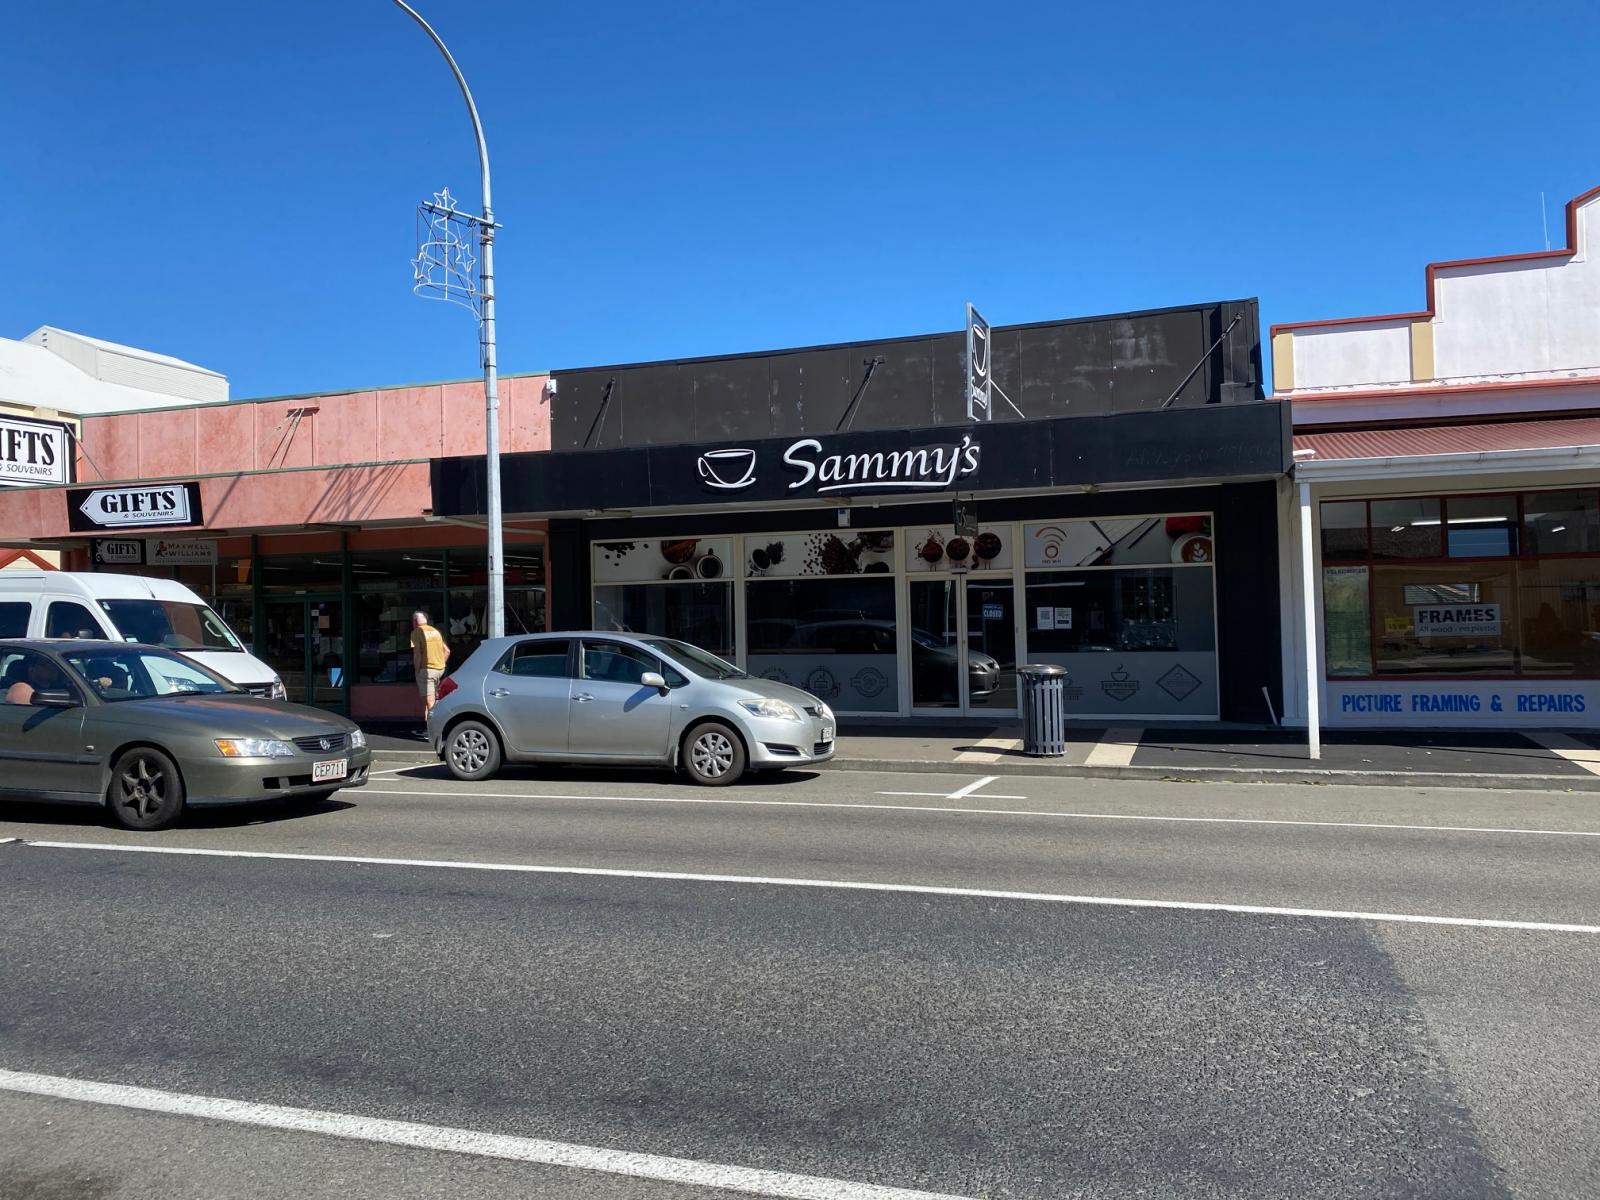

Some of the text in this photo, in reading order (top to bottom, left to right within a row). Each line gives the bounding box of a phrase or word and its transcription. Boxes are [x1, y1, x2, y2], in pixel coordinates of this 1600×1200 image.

[6, 463, 53, 476] SOUVENIRS
[782, 435, 981, 493] Sammy's
[100, 490, 176, 514] GIFTS
[132, 510, 174, 518] SOUVENIRS
[106, 543, 137, 555] GIFTS
[168, 550, 211, 558] WILLIAMS
[983, 609, 1002, 618] CLOSED
[1418, 608, 1496, 624] FRAMES
[1418, 625, 1429, 633] All
[1431, 625, 1453, 633] wood
[1342, 694, 1586, 713] PICTURE FRAMING & REPAIRS
[314, 762, 344, 778] CEP711
